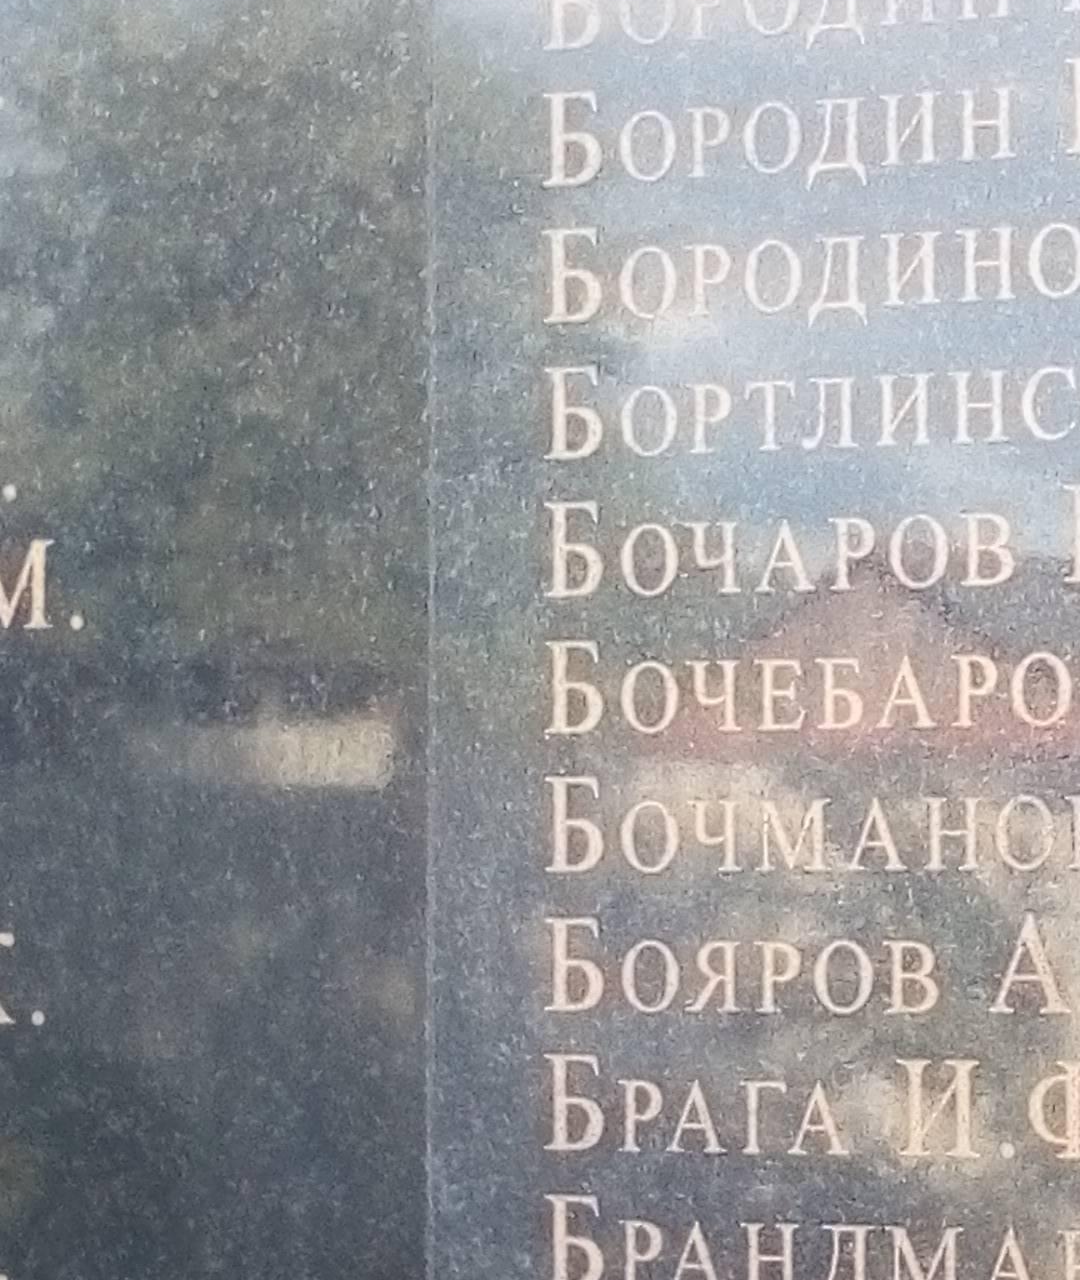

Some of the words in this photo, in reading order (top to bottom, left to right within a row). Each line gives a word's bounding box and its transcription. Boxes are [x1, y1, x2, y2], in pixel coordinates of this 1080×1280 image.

[541, 87, 1017, 189] БОРОДИН
[544, 501, 1017, 599] БОЧАРОВ
[544, 916, 940, 1016] БОЯРОВ
[543, 1053, 850, 1159] БРАГА
